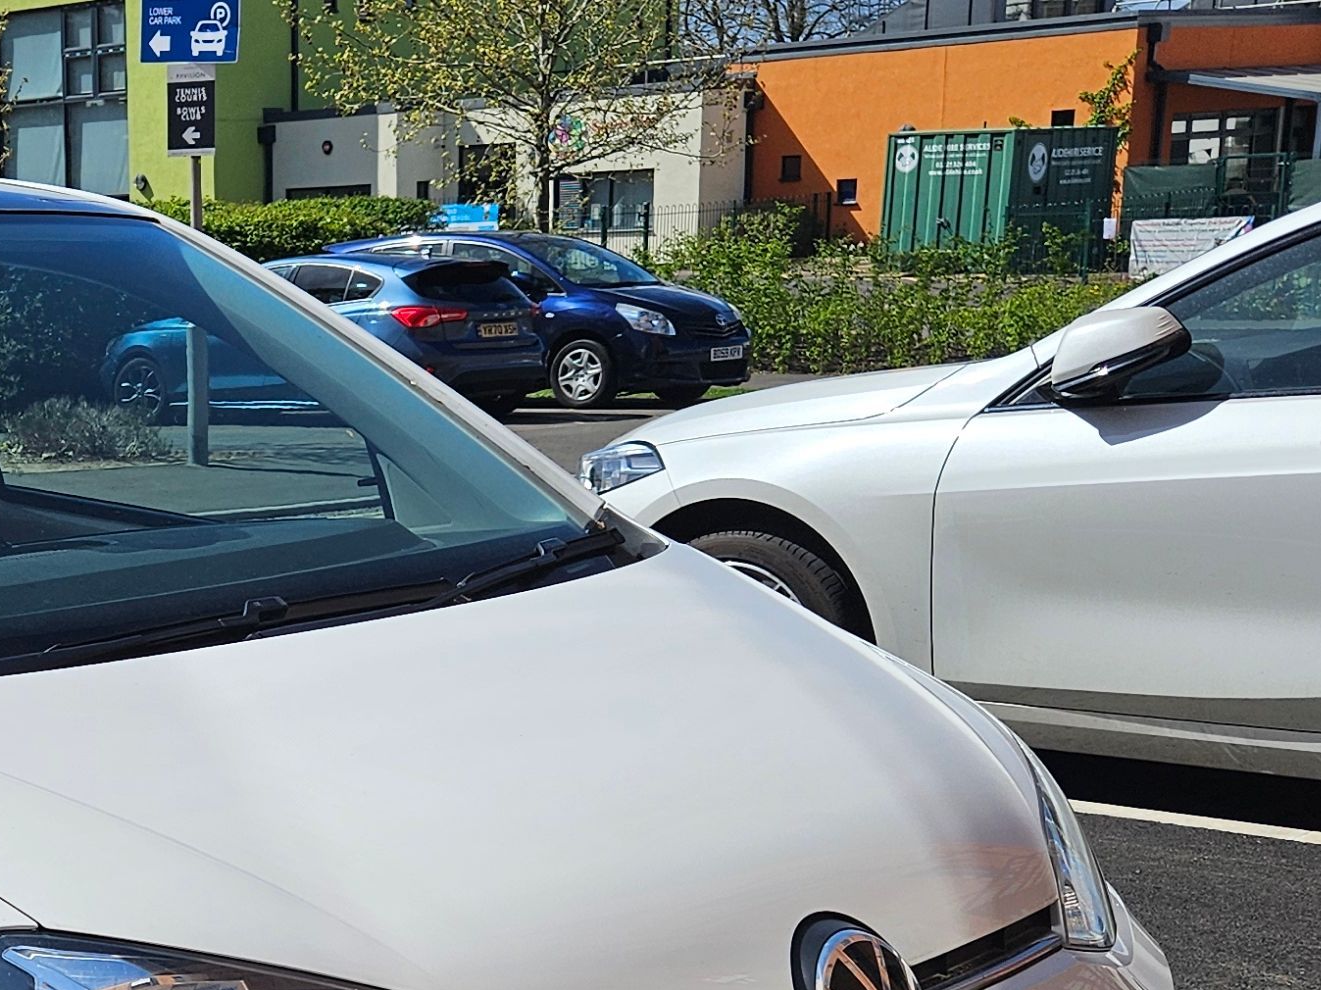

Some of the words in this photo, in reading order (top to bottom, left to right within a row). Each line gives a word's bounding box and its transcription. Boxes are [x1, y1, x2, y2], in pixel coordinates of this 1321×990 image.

[149, 7, 173, 16] LOWER
[216, 8, 226, 20] P
[148, 16, 163, 25] CAR
[164, 16, 182, 24] PARK
[175, 86, 206, 95] TENNIS
[174, 93, 208, 103] COURTS
[176, 106, 206, 115] BOWLS
[180, 111, 202, 121] CLUB
